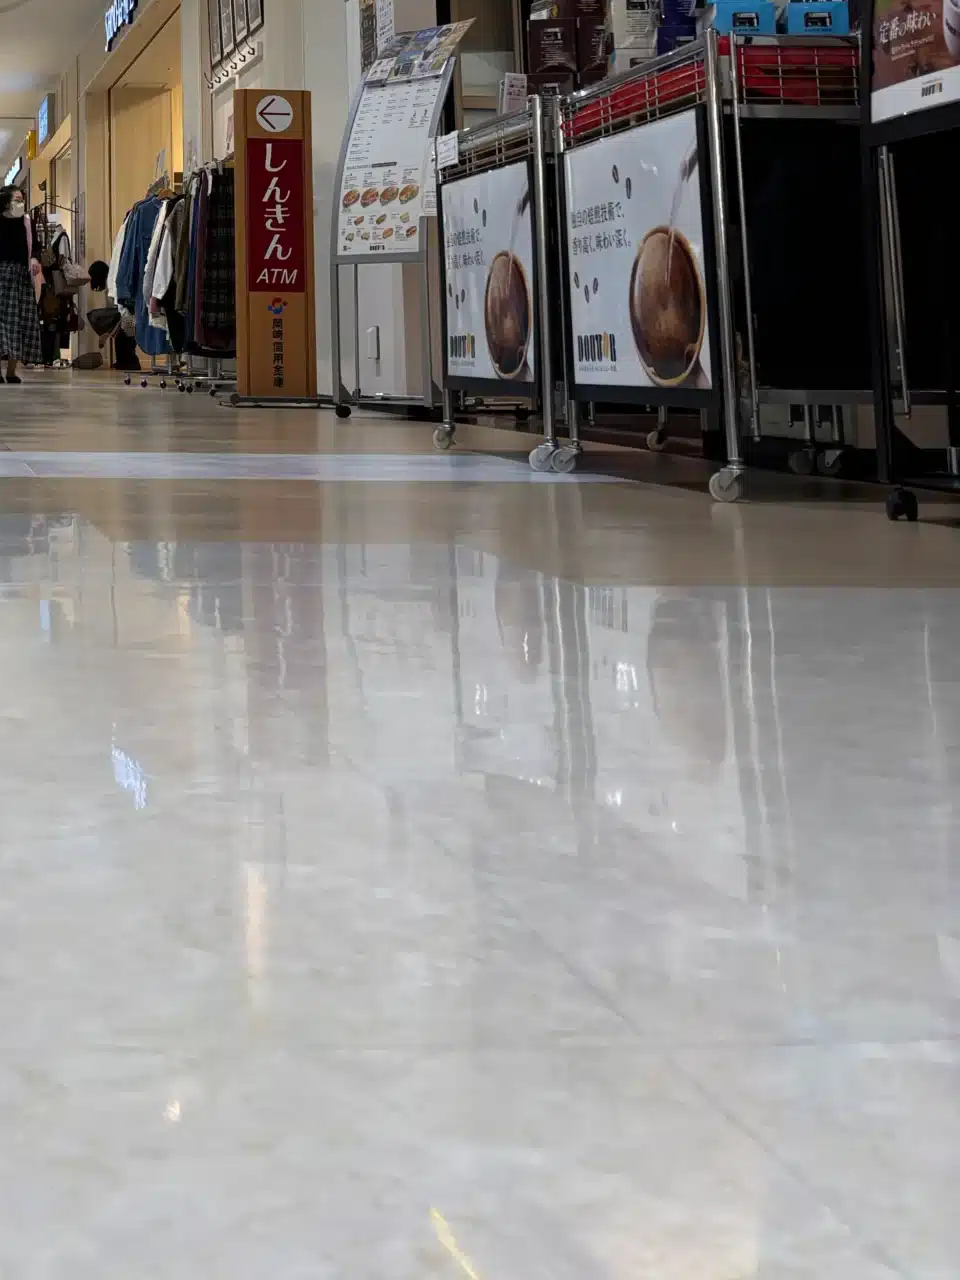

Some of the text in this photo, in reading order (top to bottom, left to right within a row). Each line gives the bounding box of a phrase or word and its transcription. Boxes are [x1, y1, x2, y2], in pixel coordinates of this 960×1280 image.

[879, 10, 937, 44] 定番の味わい
[262, 143, 292, 261] しんきん
[256, 268, 298, 285] ATM
[577, 331, 617, 363] DOUTOR
